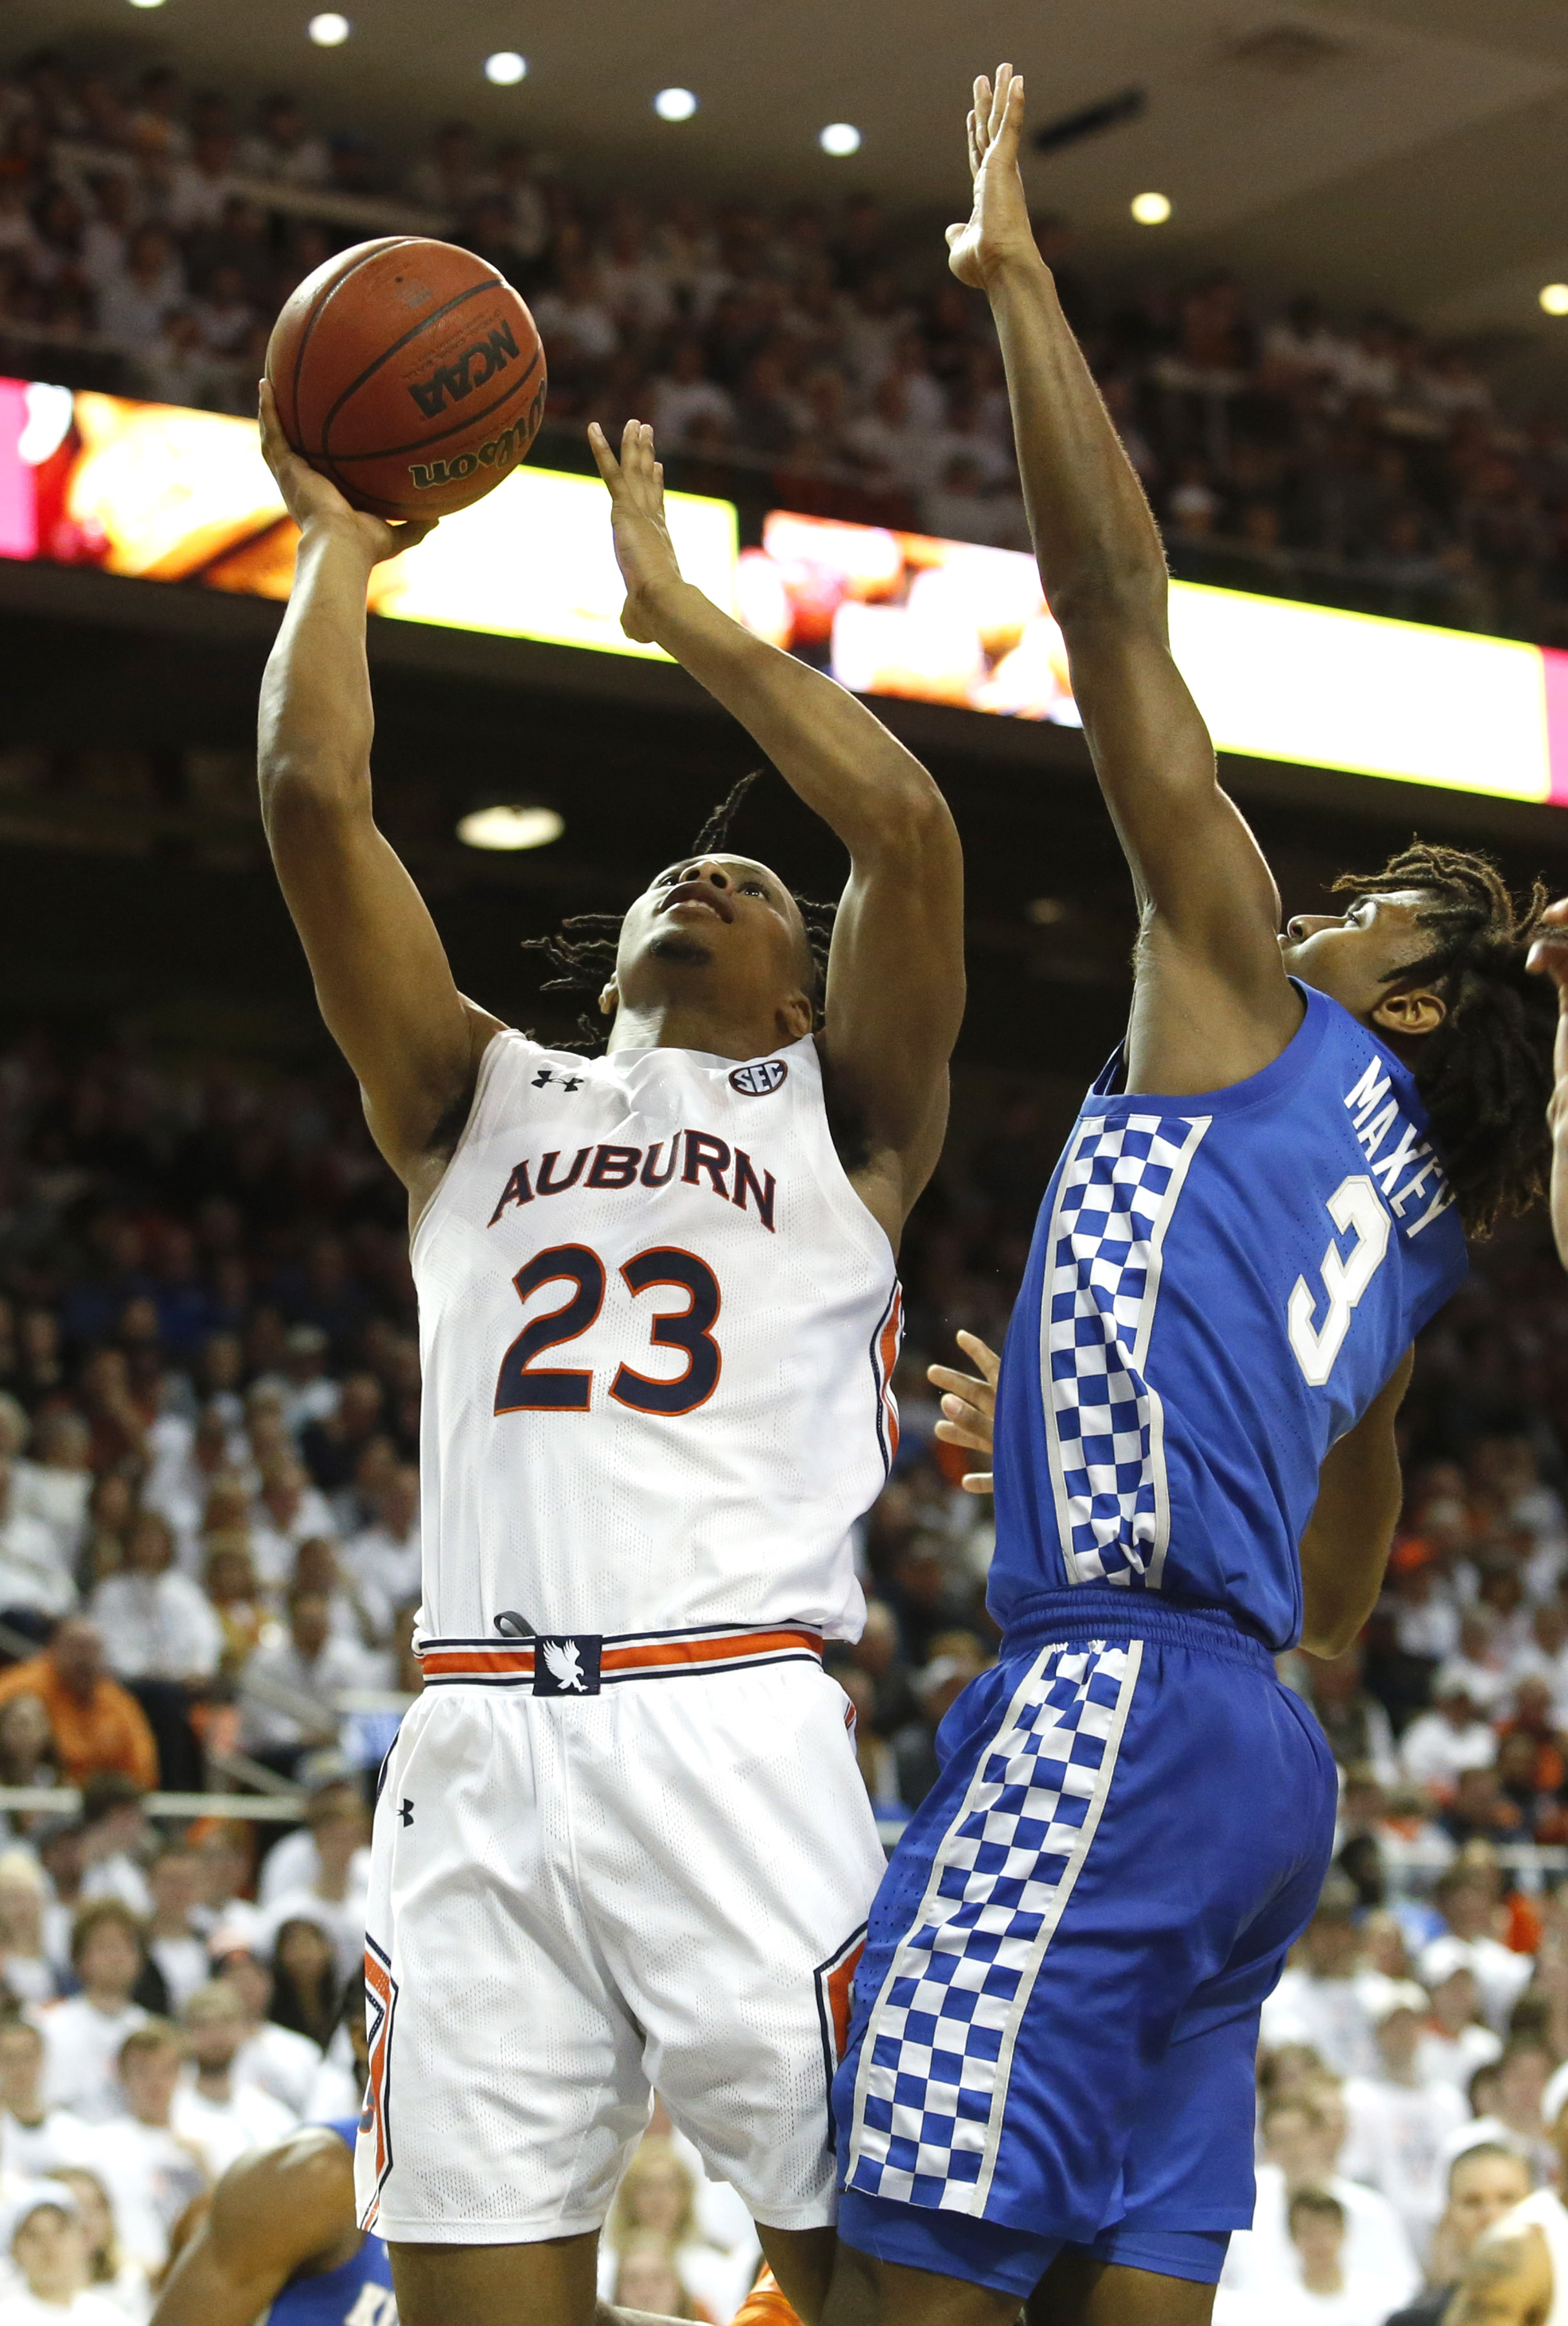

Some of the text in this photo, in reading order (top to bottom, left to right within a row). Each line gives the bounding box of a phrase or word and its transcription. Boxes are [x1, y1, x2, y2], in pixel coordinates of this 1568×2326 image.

[408, 320, 519, 419] NCAA
[733, 1062, 784, 1093] SEC
[1343, 1054, 1458, 1238] MAXEY
[487, 1129, 777, 1233] AUBURN
[494, 1242, 722, 1418] 23
[1287, 1174, 1392, 1387] 3
